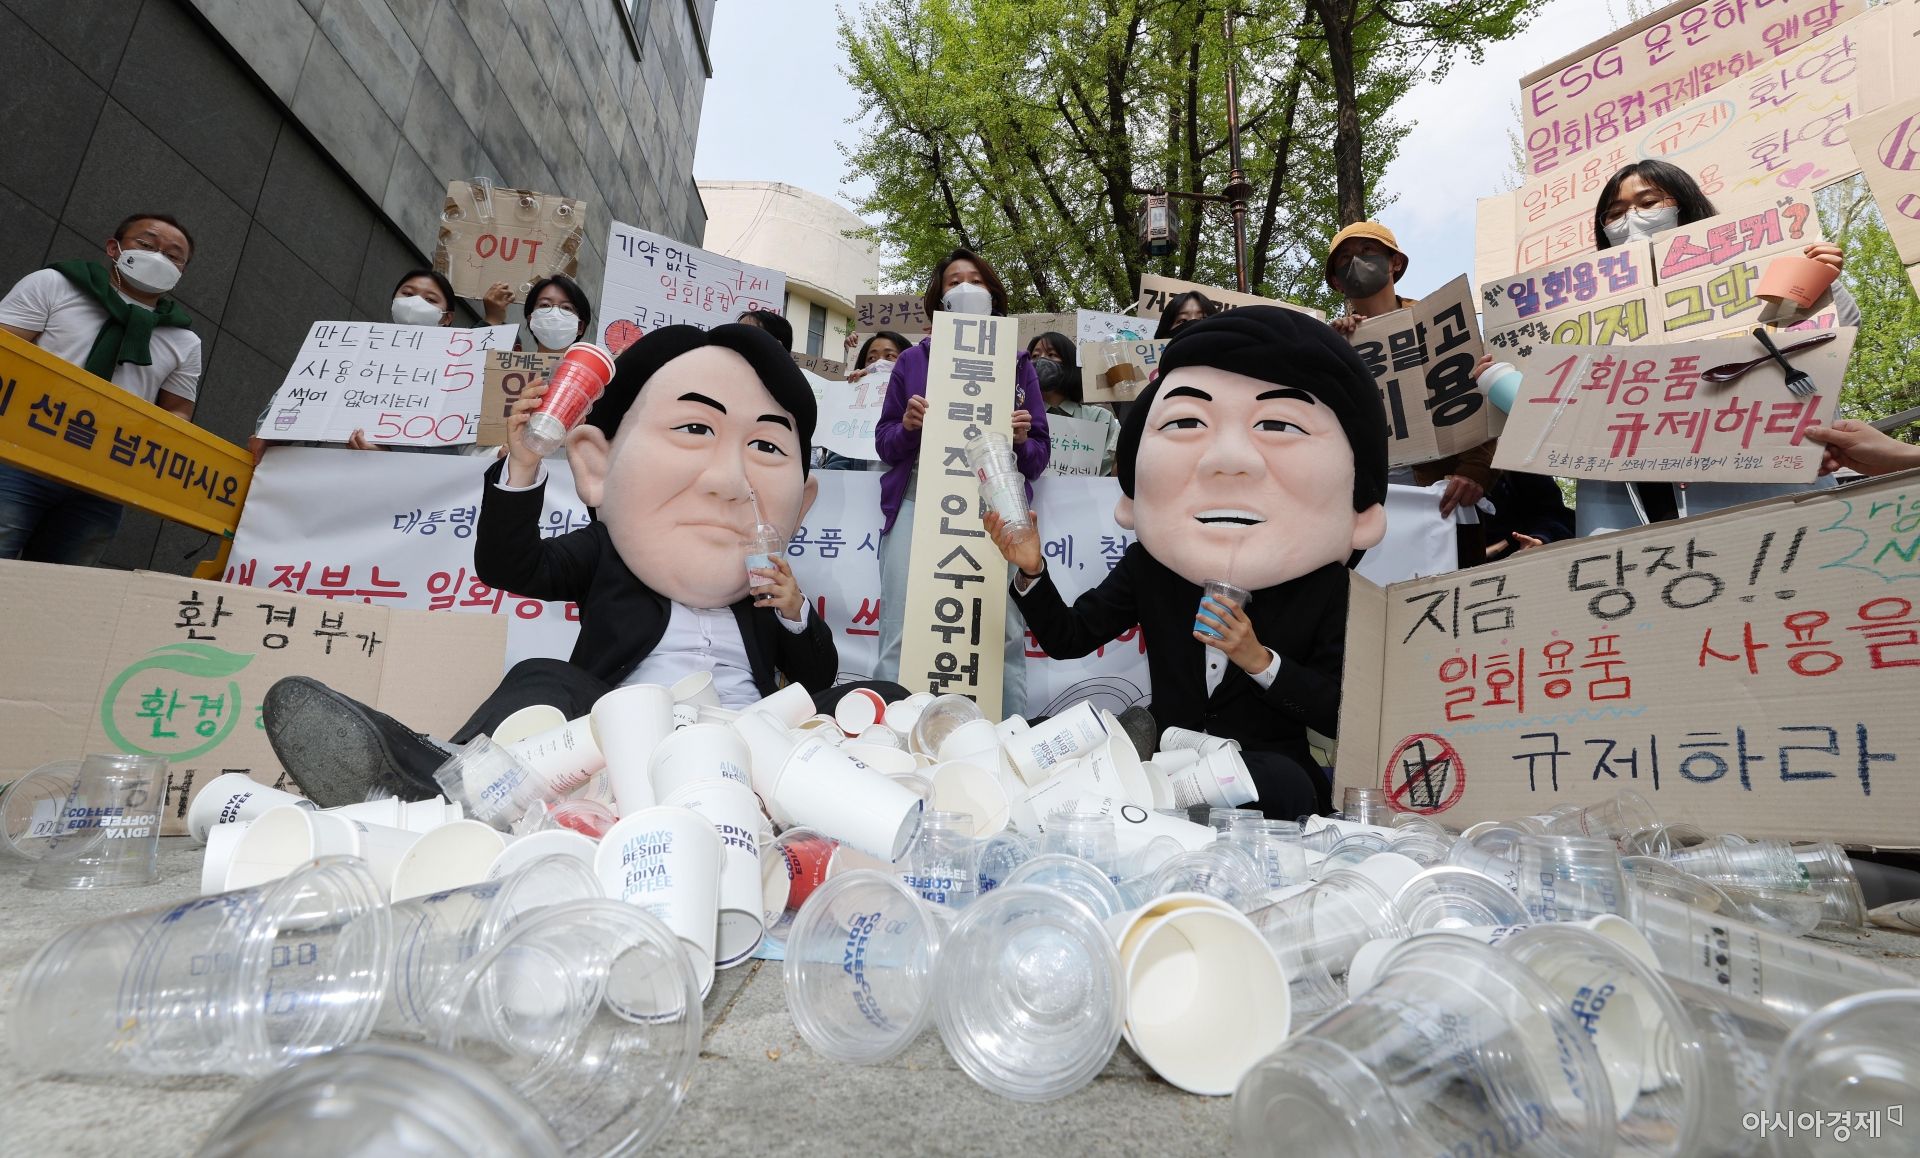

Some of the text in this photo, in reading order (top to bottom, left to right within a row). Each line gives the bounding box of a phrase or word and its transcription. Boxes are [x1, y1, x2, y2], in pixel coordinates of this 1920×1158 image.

[1532, 0, 1782, 117] ESG 운운하
[1651, 103, 1727, 155] 규제
[1750, 35, 1856, 110] 환영
[475, 234, 543, 264] OUT
[616, 234, 698, 278] 기약 없는
[660, 274, 731, 313] 일회용컵
[1507, 250, 1638, 318] 일회용컵
[1552, 298, 1648, 345] 이제
[1664, 262, 1762, 332] 그만
[315, 326, 423, 350] 만드는데
[858, 303, 925, 327] 환경부는
[299, 359, 436, 386] 사용하는데
[496, 351, 543, 370] 핑계는
[1529, 354, 1701, 406] 1회용품
[288, 387, 429, 408] 썩어 없어지는데
[28, 393, 98, 450] 선을
[109, 427, 238, 507] 넘지마시오
[1607, 395, 1823, 458] 규제하라
[174, 590, 383, 658] 환경부가
[1403, 574, 1520, 645] 지금
[1439, 597, 1920, 722] 일회용품 사용을
[135, 687, 225, 739] 환경
[1512, 723, 1896, 797] 규제하라
[229, 792, 253, 823] OFFEE
[623, 843, 672, 866] BESIDE
[721, 836, 759, 859] OFFEE
